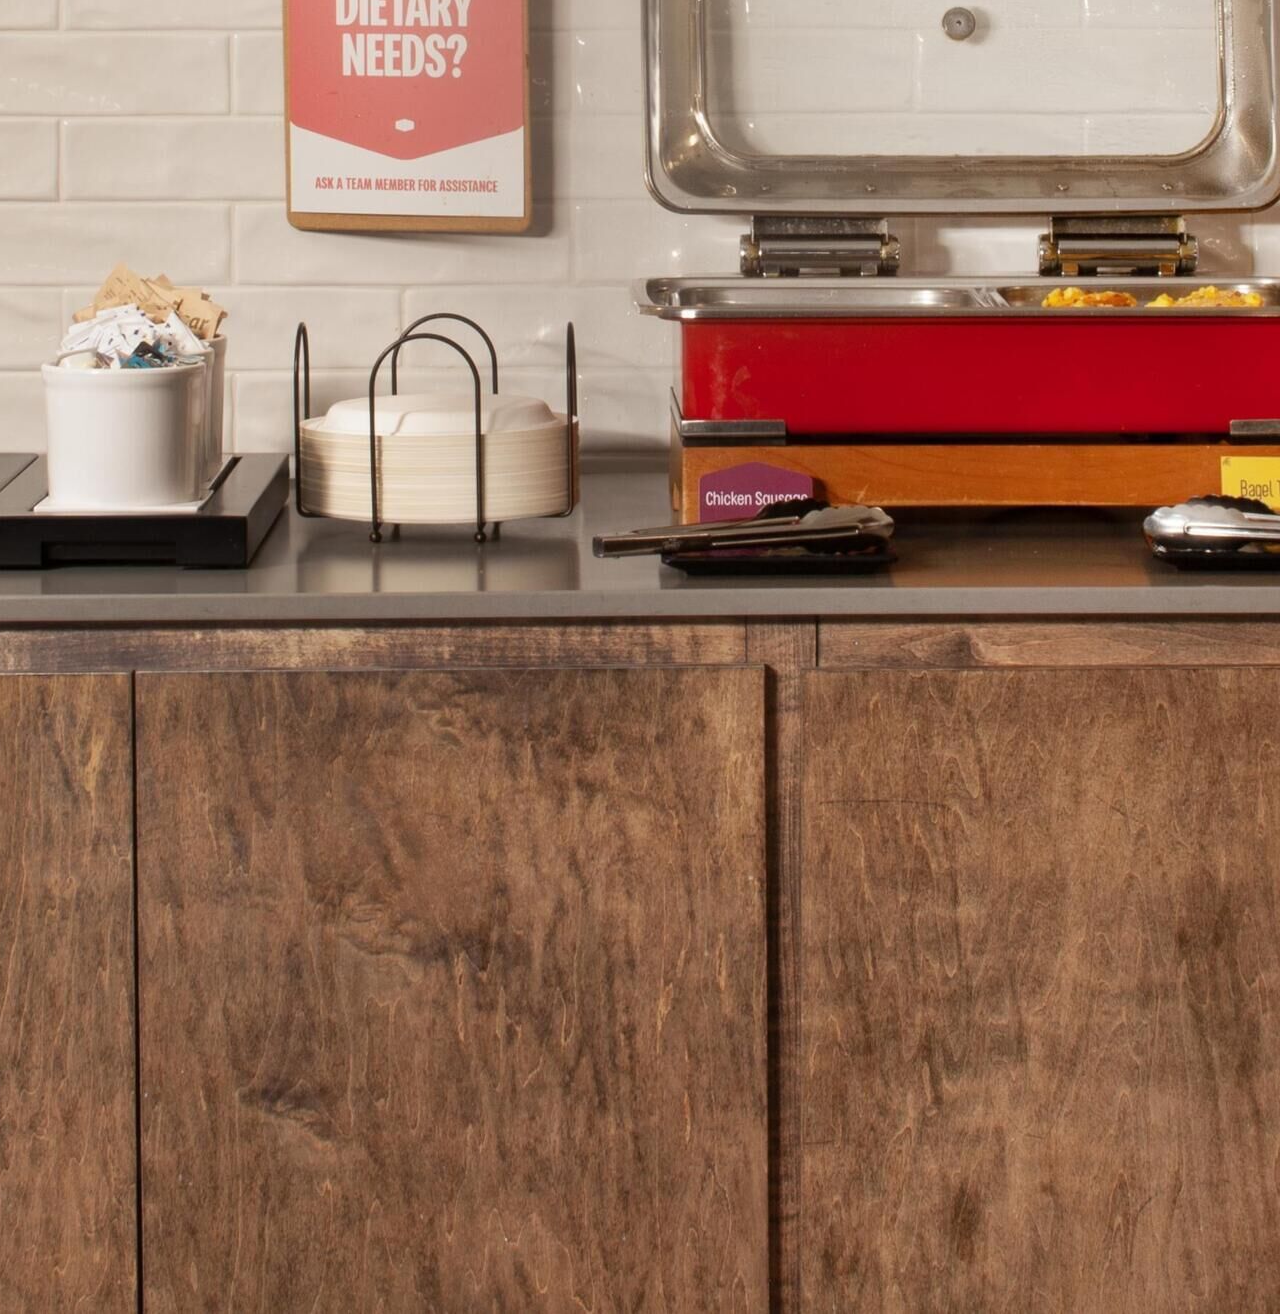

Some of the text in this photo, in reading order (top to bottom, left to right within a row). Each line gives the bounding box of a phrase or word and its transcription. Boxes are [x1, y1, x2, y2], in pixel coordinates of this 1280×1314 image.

[342, 32, 468, 79] NEEDS?
[315, 176, 498, 193] ASK A TEAM MEMBER FOR ASSISTANCE
[705, 491, 753, 506] Chicken
[1240, 479, 1274, 500] Bagel
